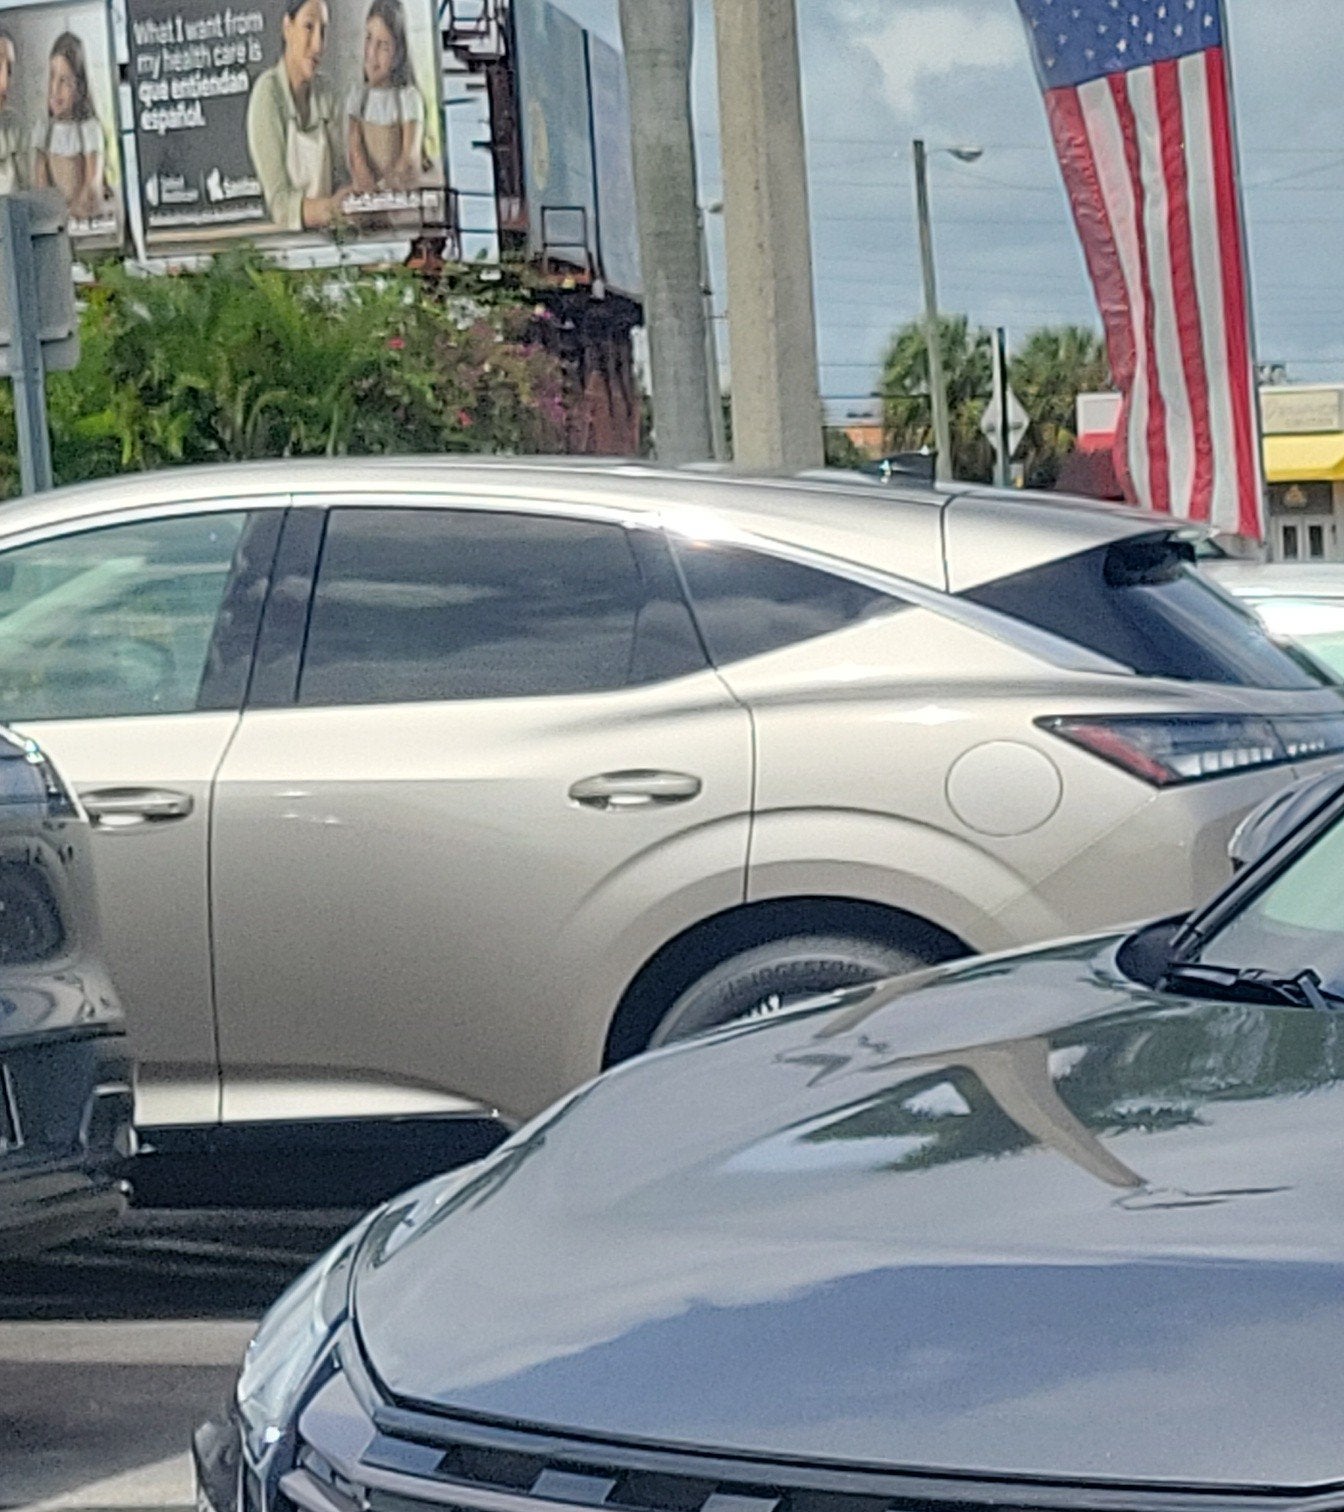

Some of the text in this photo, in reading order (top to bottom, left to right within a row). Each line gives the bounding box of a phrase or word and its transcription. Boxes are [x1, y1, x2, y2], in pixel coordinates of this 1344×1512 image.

[133, 17, 173, 45] What
[184, 13, 224, 40] want
[225, 7, 263, 37] from
[137, 36, 262, 80] my health care is
[139, 79, 169, 107] que
